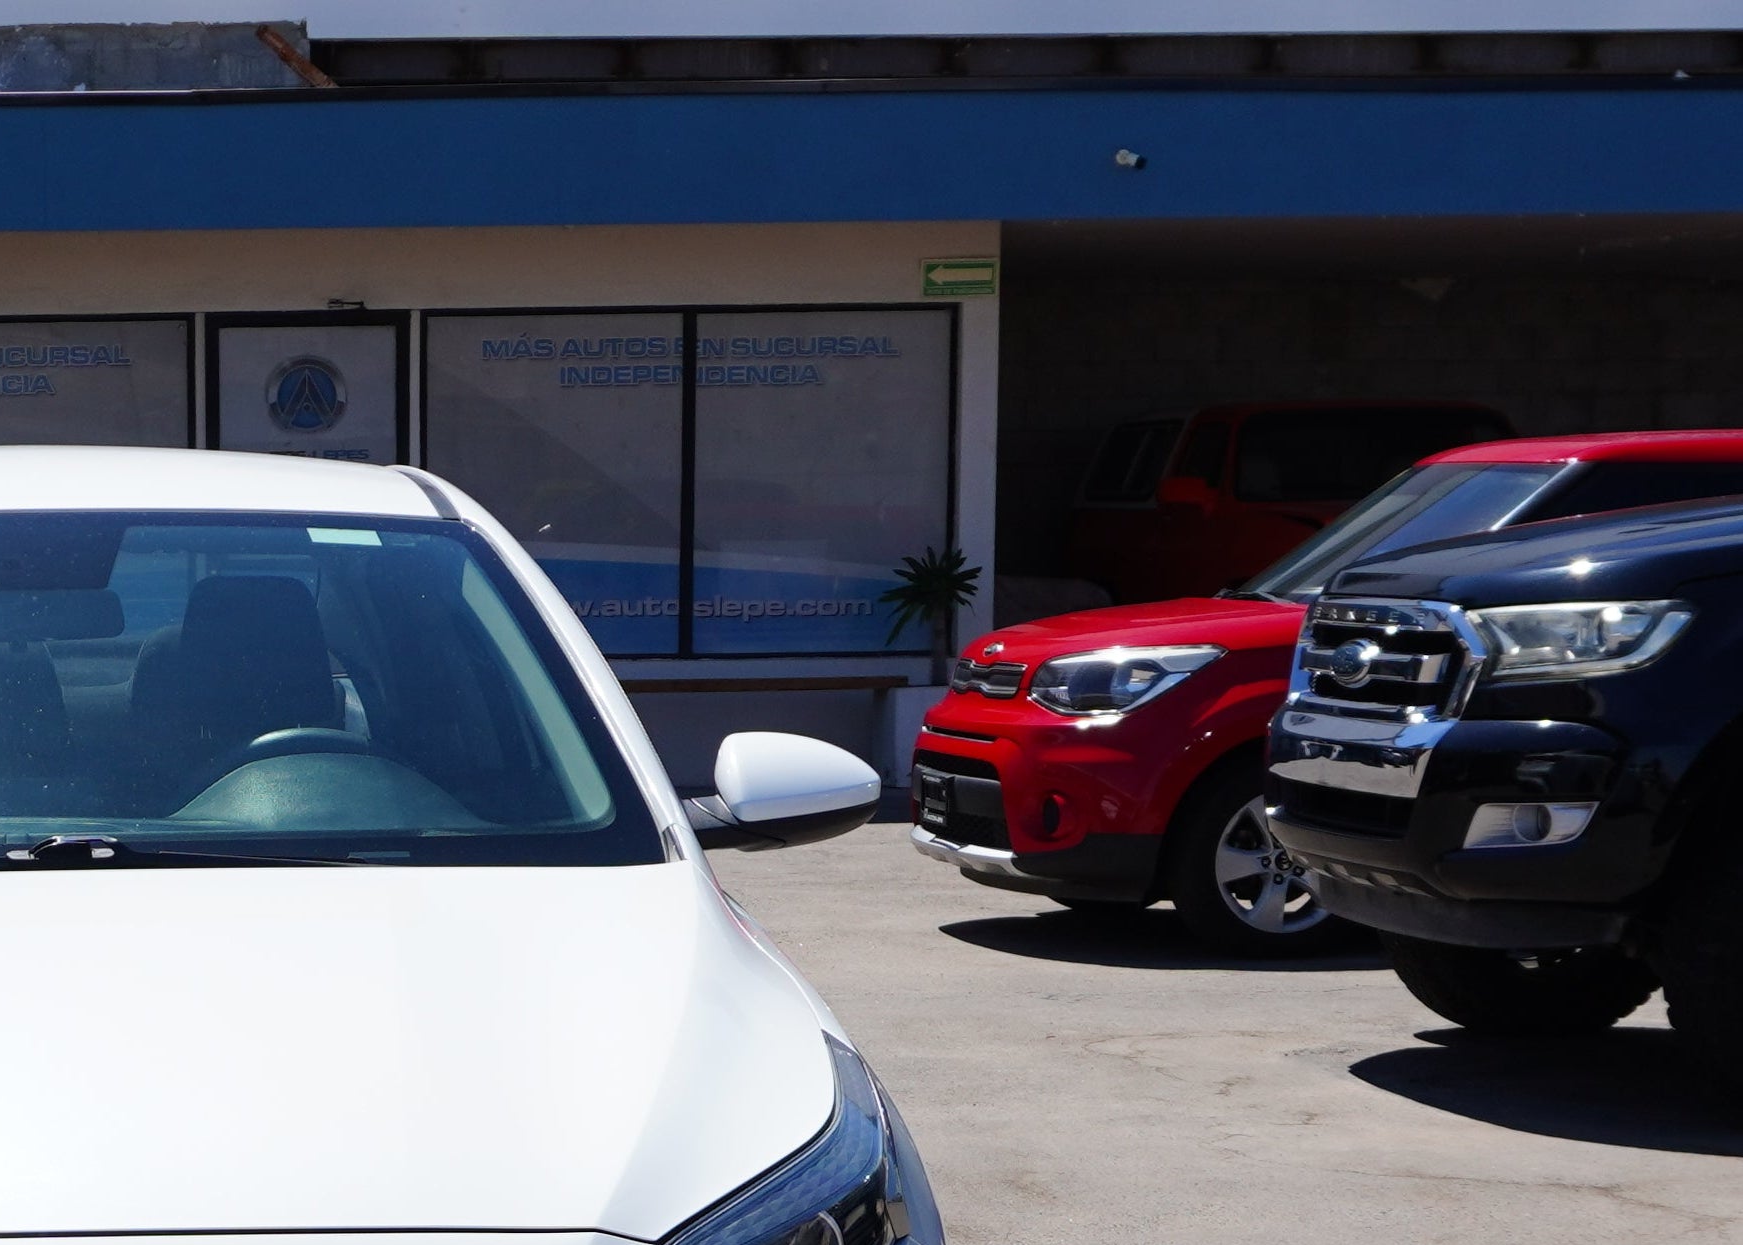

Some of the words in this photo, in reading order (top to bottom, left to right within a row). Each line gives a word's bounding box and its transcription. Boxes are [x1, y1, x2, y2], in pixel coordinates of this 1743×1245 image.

[481, 333, 555, 360] MÁS
[558, 337, 667, 358] AUTOS
[730, 336, 899, 357] SUCURSAL
[560, 365, 821, 386] INDEPENDENCIA
